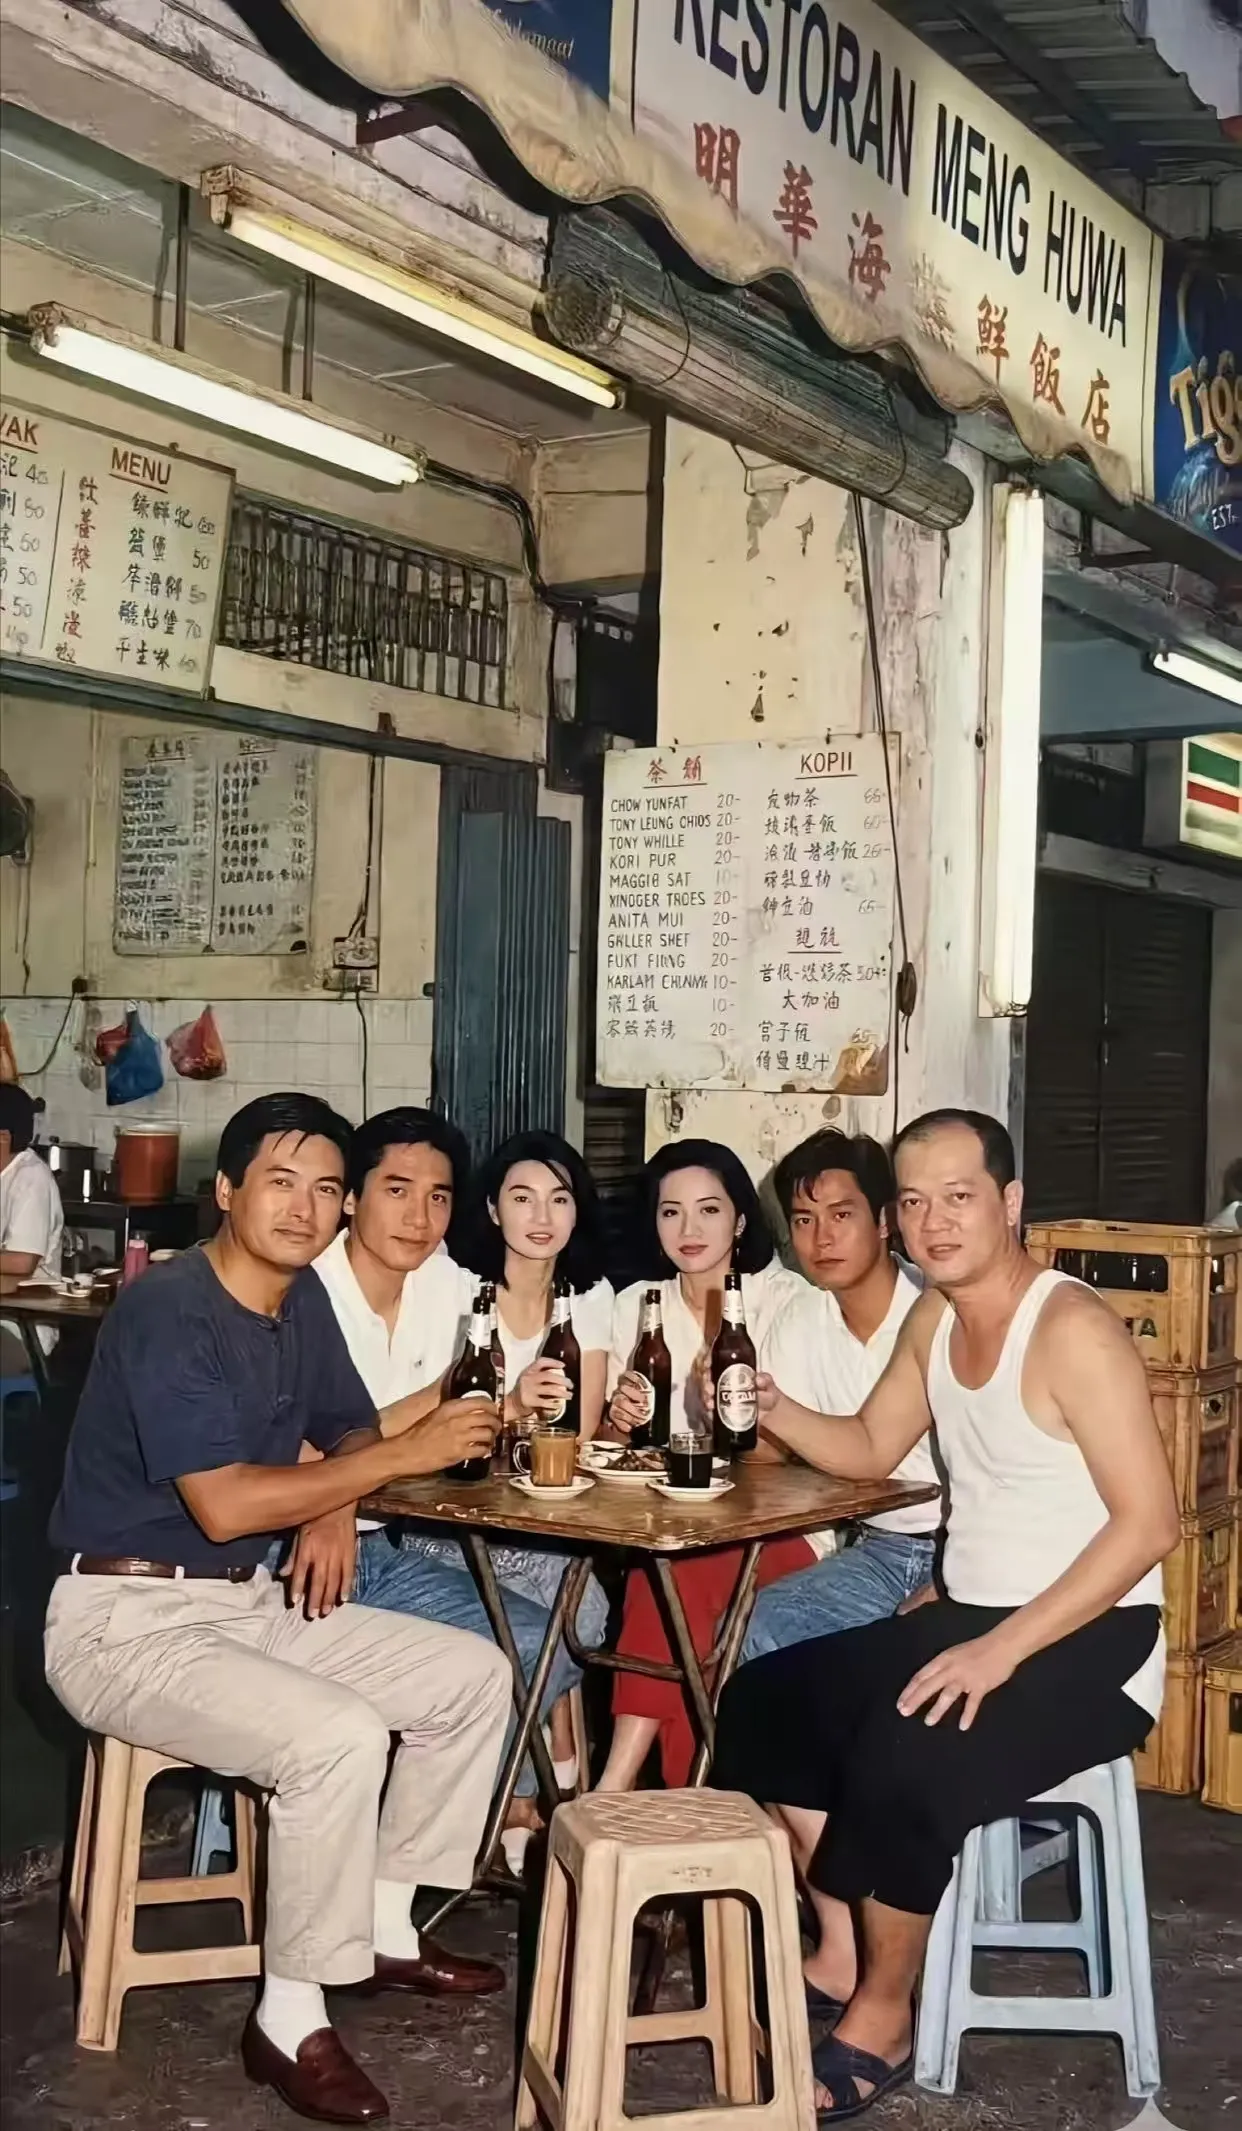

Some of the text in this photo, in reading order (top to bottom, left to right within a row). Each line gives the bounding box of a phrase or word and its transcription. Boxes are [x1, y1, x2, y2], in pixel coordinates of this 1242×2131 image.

[932, 103, 1031, 276] MENG
[1044, 190, 1127, 348] HUWA
[0, 414, 39, 446] AK
[111, 446, 171, 485] MENU
[17, 566, 37, 586] 50
[610, 799, 641, 813] CHOW
[646, 796, 688, 812] YUNFAT
[610, 818, 636, 832] TONY
[640, 816, 674, 830] LEUNG
[609, 836, 638, 851] TONY
[609, 854, 640, 869] KORI
[649, 852, 677, 868] PUR
[667, 872, 691, 887] SAT
[608, 912, 649, 928] ANITA
[658, 912, 684, 927] MUI
